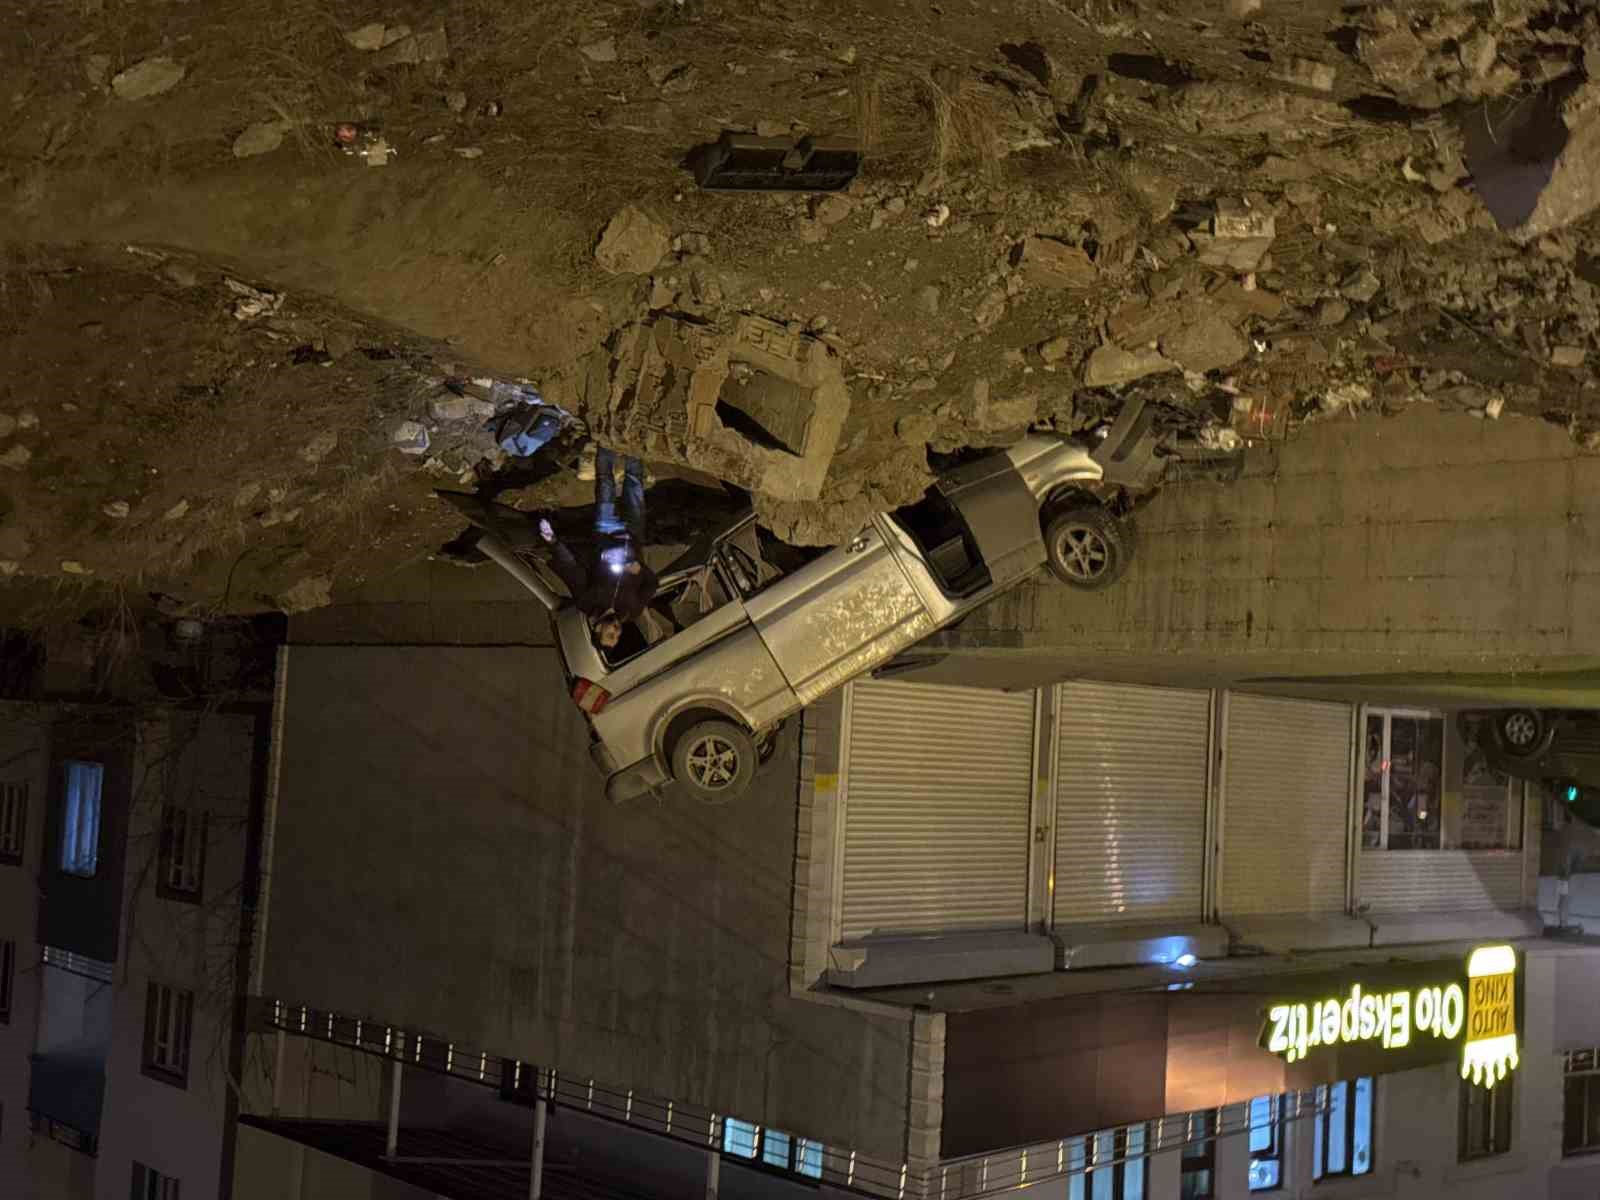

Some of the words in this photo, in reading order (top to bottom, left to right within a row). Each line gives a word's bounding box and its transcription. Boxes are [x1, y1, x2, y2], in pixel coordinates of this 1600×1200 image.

[1475, 976, 1509, 1002] KING
[1269, 983, 1411, 1063] Ekspertiz
[1415, 983, 1463, 1039] Oto
[1474, 1006, 1510, 1034] AUTO
